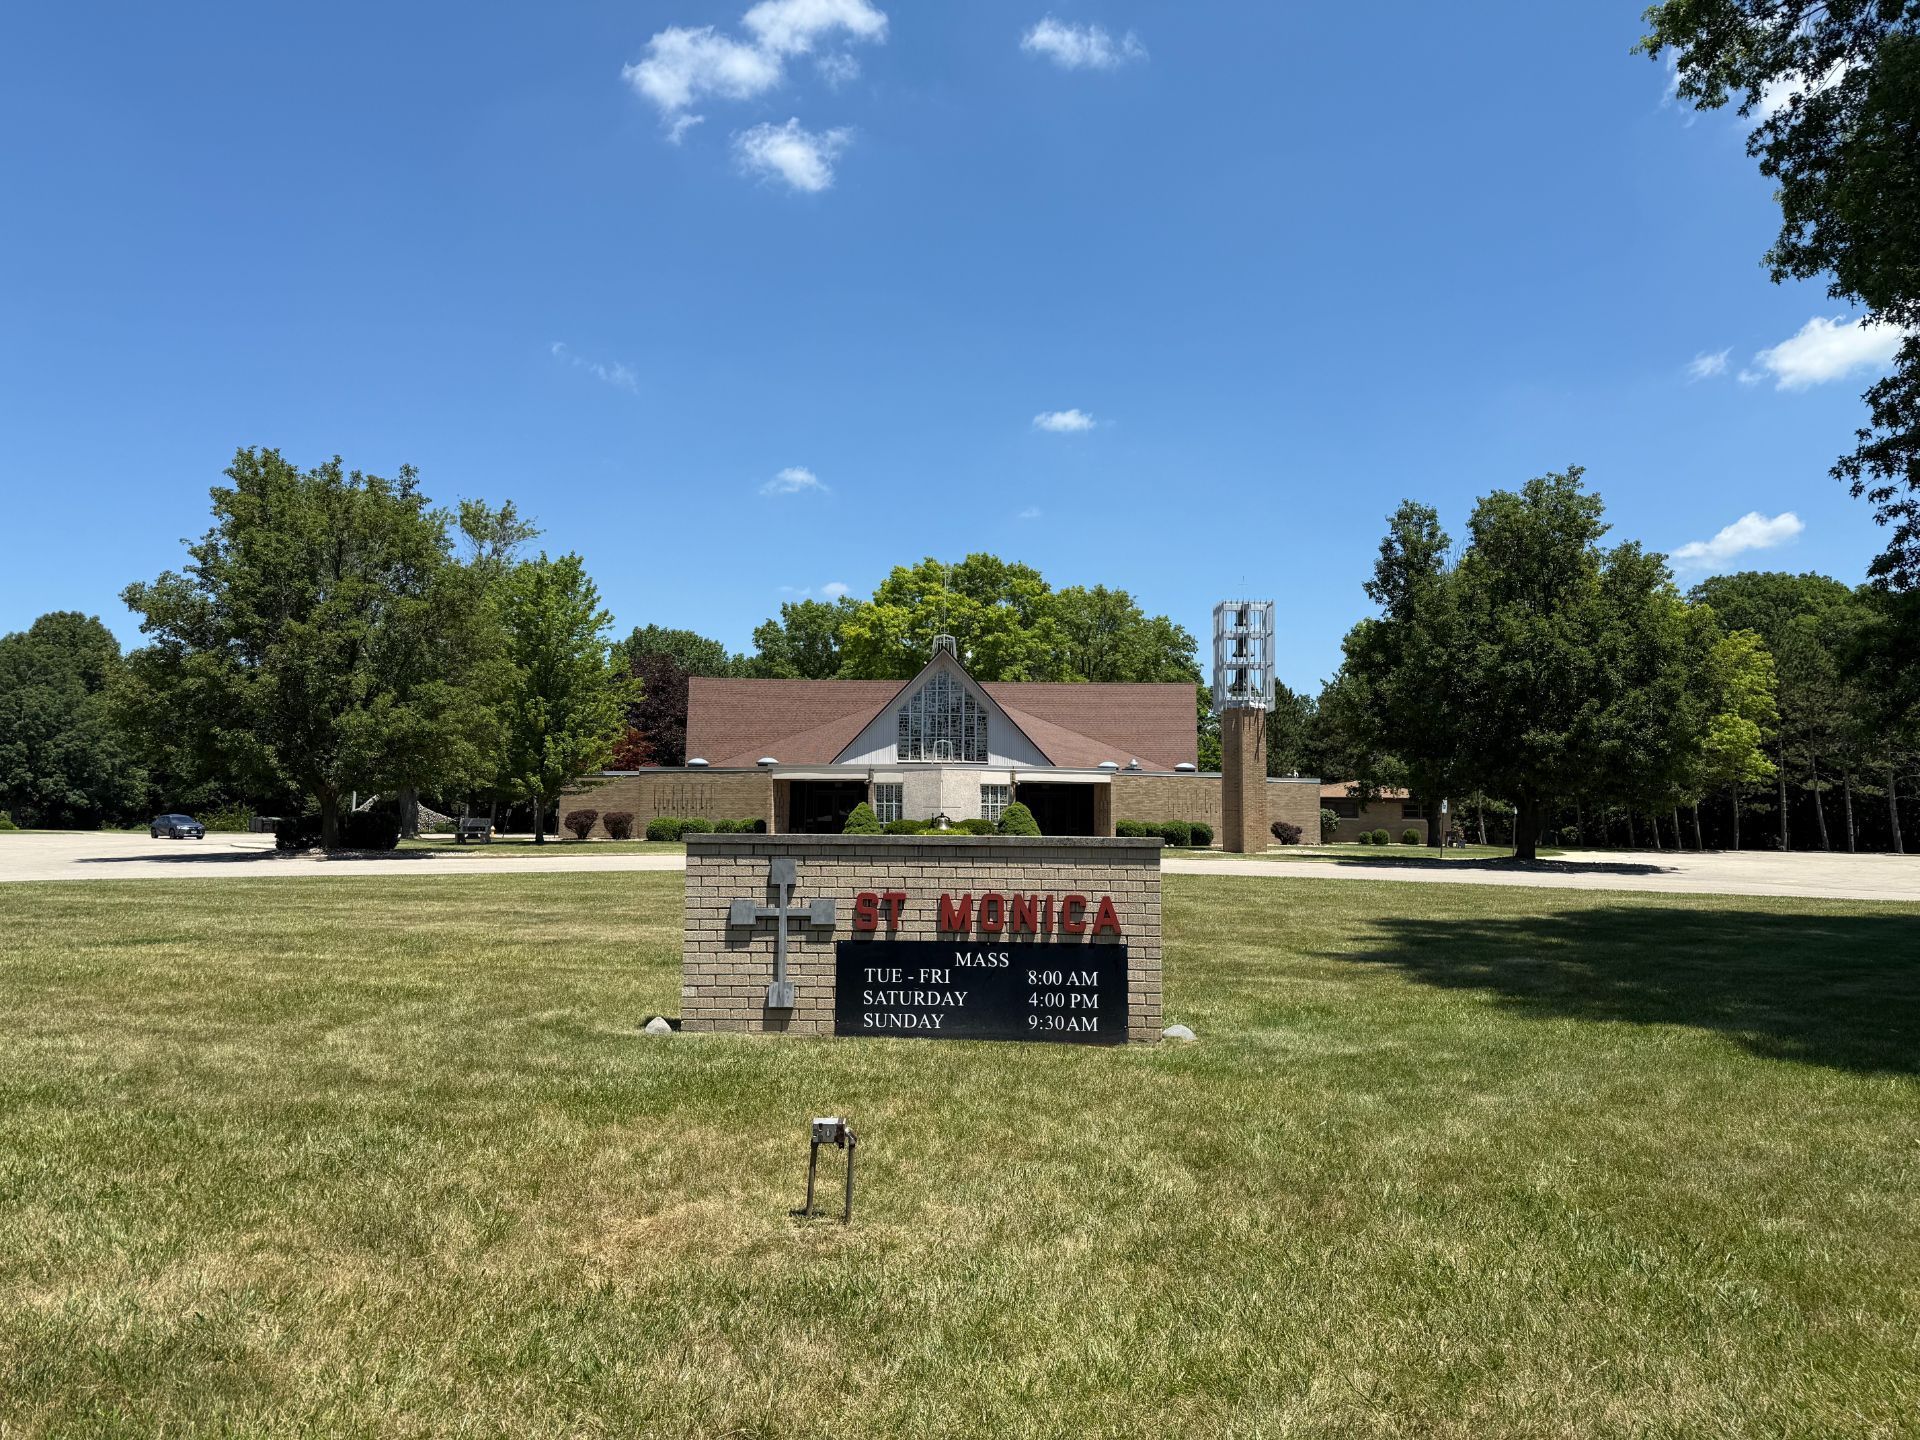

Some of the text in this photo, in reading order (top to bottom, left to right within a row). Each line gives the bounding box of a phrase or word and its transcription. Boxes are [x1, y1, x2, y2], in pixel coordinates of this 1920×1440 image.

[855, 892, 1121, 934] ST MONICA
[954, 952, 1009, 968] MASS
[864, 968, 903, 983] TUE
[919, 968, 951, 984] FRI
[1028, 970, 1062, 986] 8:00
[1065, 971, 1099, 987] AM
[863, 990, 1099, 1009] SATURDAY 4:00 PM
[863, 1012, 945, 1029] SUNDAY
